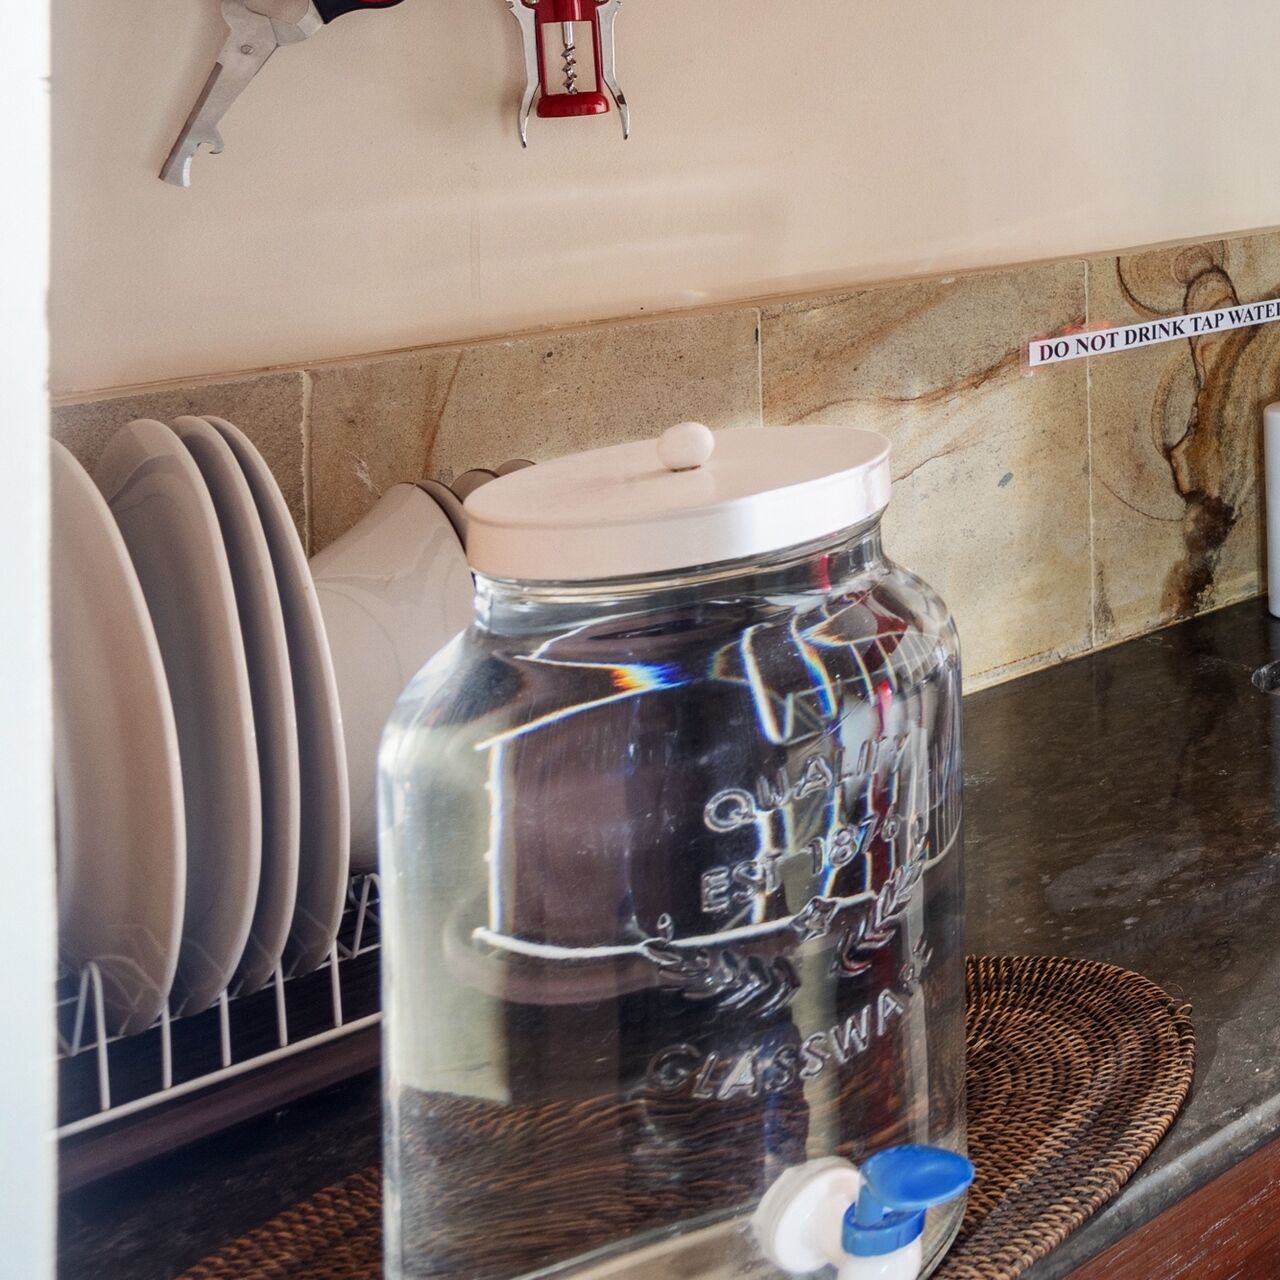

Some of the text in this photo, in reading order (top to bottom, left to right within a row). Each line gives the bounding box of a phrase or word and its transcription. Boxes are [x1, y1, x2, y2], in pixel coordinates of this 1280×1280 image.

[1039, 341, 1070, 361] DO
[1075, 332, 1120, 354] NOT
[1124, 319, 1185, 346] DRINK
[1190, 313, 1225, 332] TAP
[702, 850, 784, 914] EST
